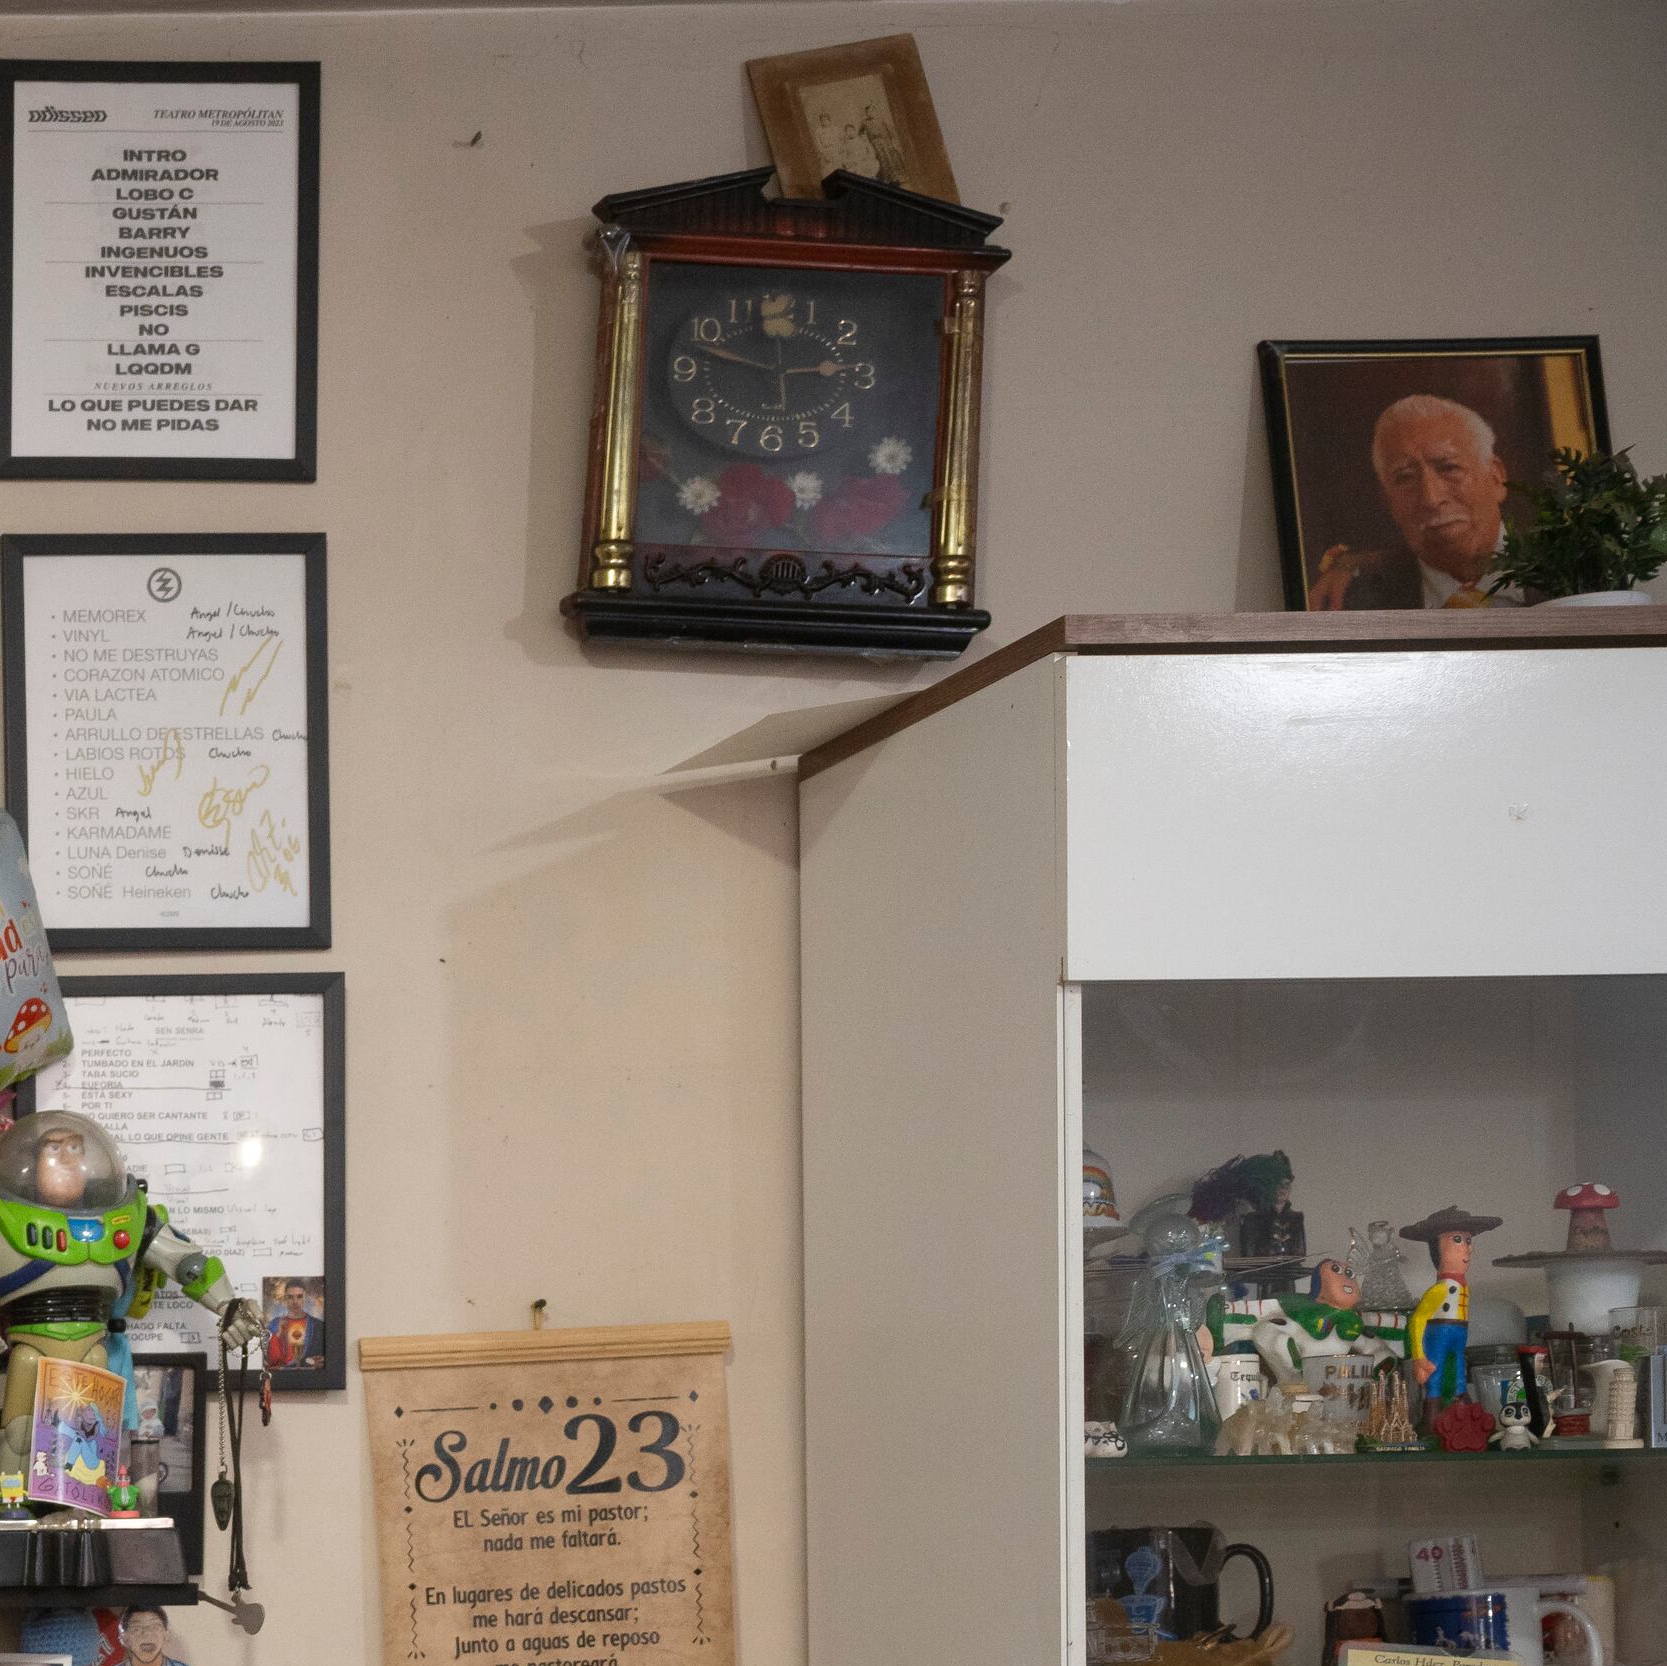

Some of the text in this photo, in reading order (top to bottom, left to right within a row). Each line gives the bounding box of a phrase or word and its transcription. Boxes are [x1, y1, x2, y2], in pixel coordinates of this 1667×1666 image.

[122, 149, 187, 162] INTRO
[90, 168, 219, 182] ADMIRADOR
[115, 187, 194, 201] LOBO C
[111, 204, 197, 220] GUSTÁN
[118, 226, 191, 239] BARRY
[100, 245, 209, 259] INGENUOS
[84, 265, 224, 278] INVENCIBLES
[105, 284, 204, 298] ESCALAS
[119, 303, 189, 317] PISCIS
[138, 322, 170, 336] NO
[692, 318, 722, 342] 10
[838, 320, 857, 345] 2
[107, 343, 201, 356] LLAMA G
[673, 357, 697, 382] 9
[855, 363, 875, 389] 3
[692, 400, 716, 425] 8
[830, 402, 855, 427] 4
[727, 419, 748, 445] 7
[759, 427, 784, 452] 6
[798, 422, 820, 448] 5
[62, 609, 147, 623] MEMOREX
[61, 628, 111, 643] VINYL
[64, 707, 117, 721] PAULA
[66, 825, 171, 840] KARMADAME
[414, 1410, 687, 1503] Salmo 23
[479, 1507, 529, 1527] Señor
[535, 1510, 555, 1525] es
[560, 1504, 582, 1523] mi
[587, 1504, 648, 1527] pastor;
[483, 1527, 621, 1552] nada me faltará.
[1416, 1546, 1444, 1562] 40
[424, 1578, 687, 1607] En lugares de delicados pastos
[470, 1606, 639, 1628] me hará descansar;
[1374, 1654, 1411, 1666] Carlos
